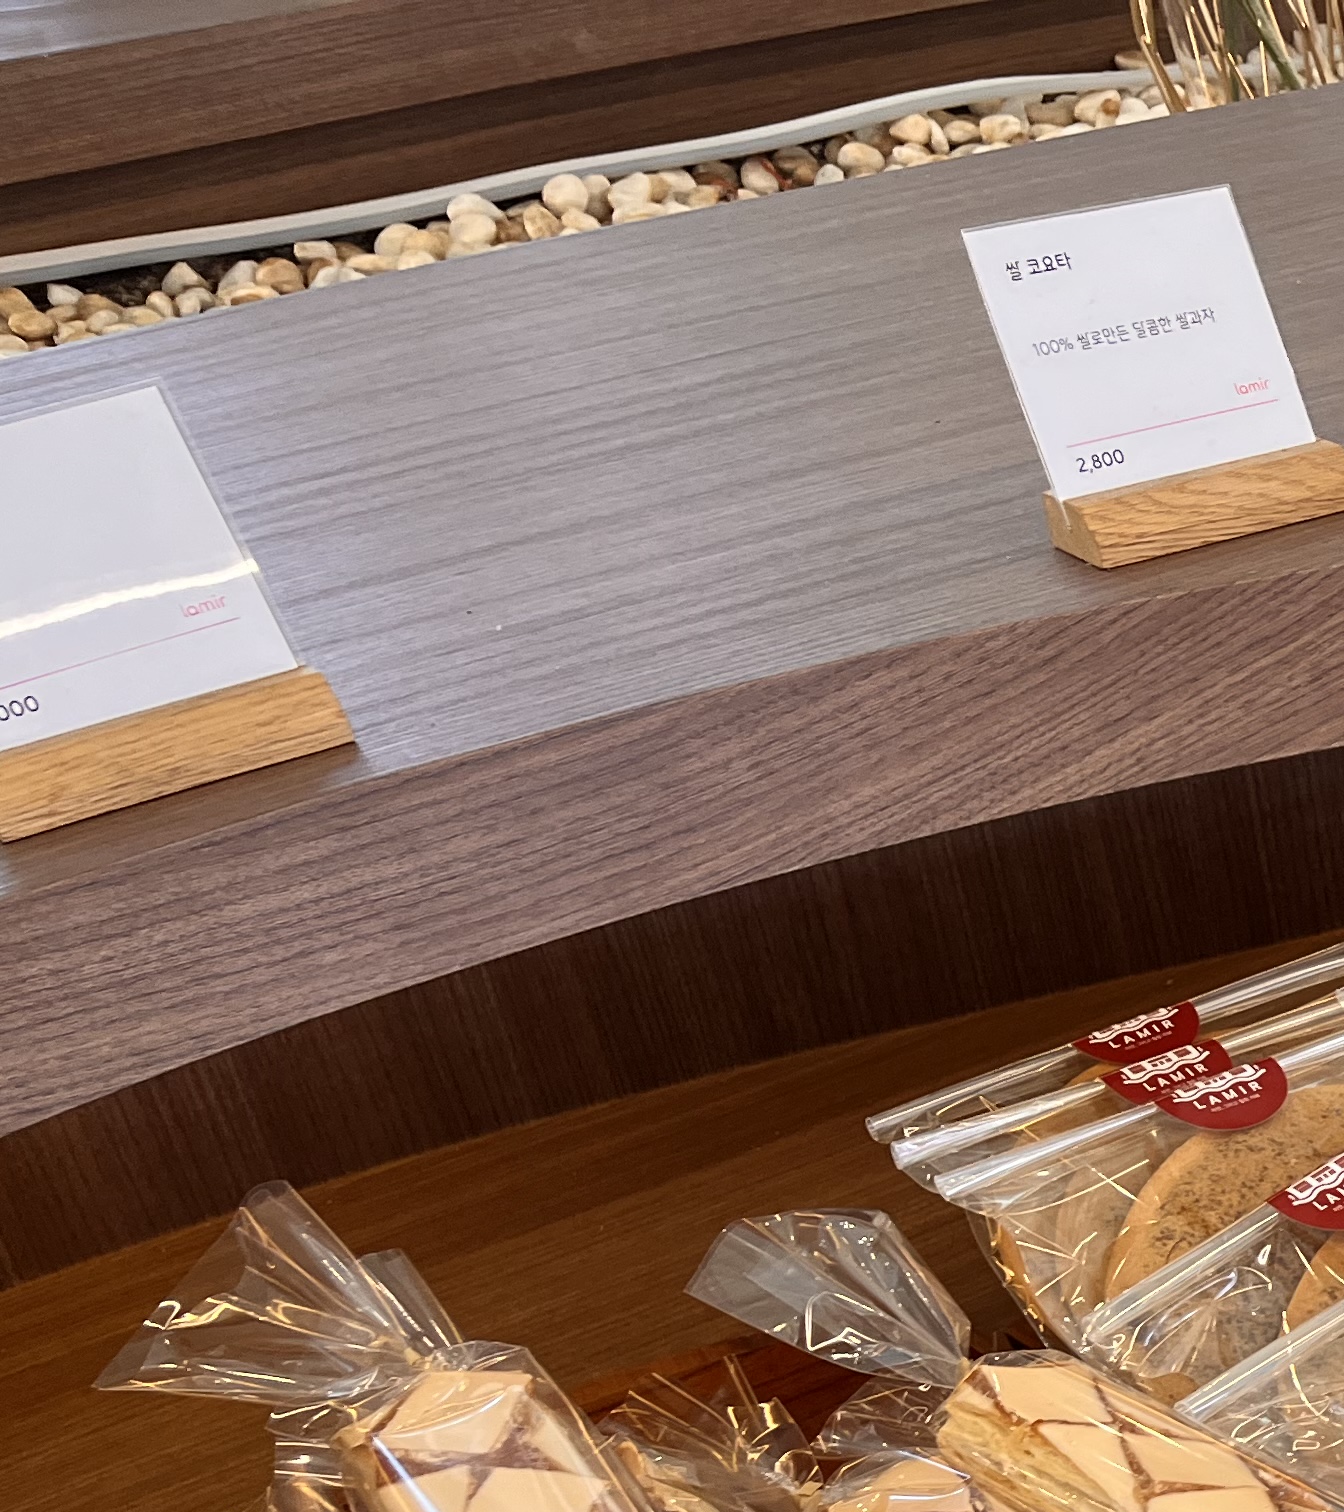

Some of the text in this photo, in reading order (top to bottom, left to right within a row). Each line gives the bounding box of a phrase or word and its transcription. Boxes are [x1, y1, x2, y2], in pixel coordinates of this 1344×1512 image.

[1005, 252, 1073, 282] 쌀 코요타
[1032, 307, 1217, 358] 100% 쌀로만든 달콤한 쌀과자
[1234, 377, 1271, 396] lamir
[1076, 449, 1126, 474] 2,800
[181, 594, 228, 618] lamir
[1109, 1019, 1175, 1049] LAMIR
[1143, 1063, 1209, 1092] LAMIR
[1193, 1081, 1263, 1110] LAMIR
